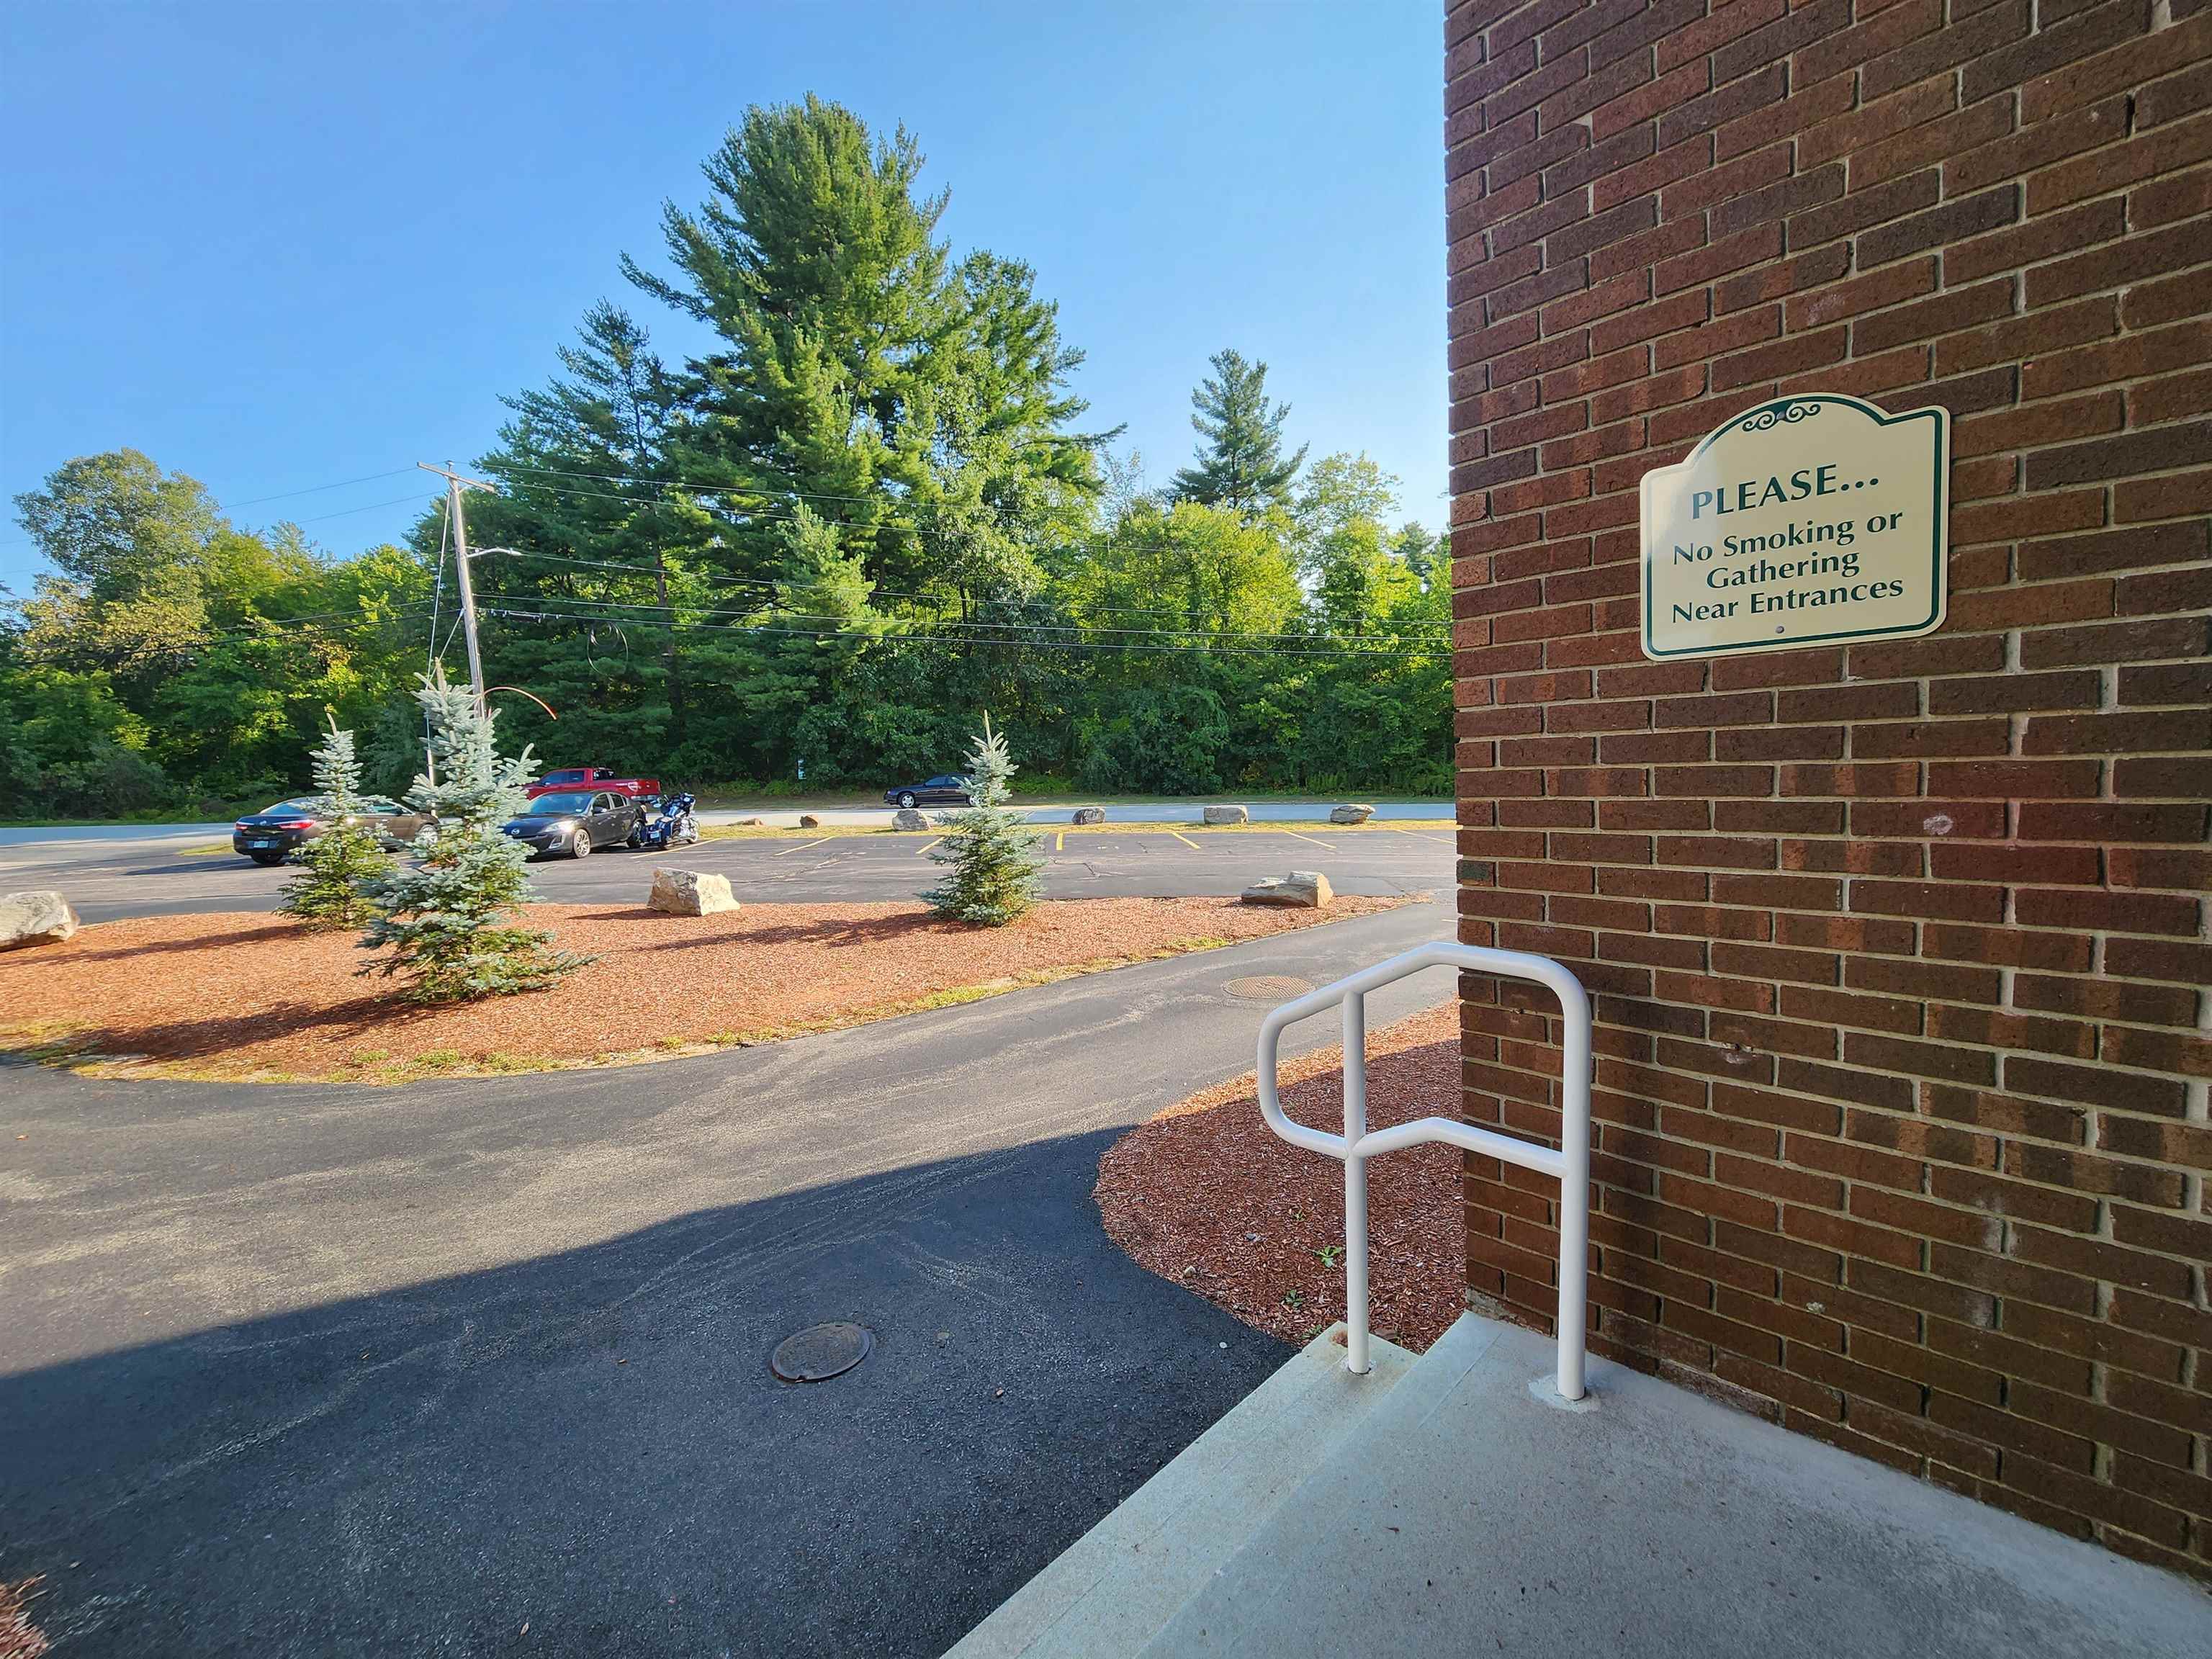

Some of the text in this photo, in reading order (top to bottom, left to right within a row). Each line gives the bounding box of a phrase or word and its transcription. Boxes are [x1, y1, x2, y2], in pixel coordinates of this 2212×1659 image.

[1691, 464, 1879, 519] PLEASE...
[1673, 512, 1903, 565] No Smoking or
[1706, 552, 1860, 589] Gathering
[1672, 579, 1904, 623] Near Entrances
